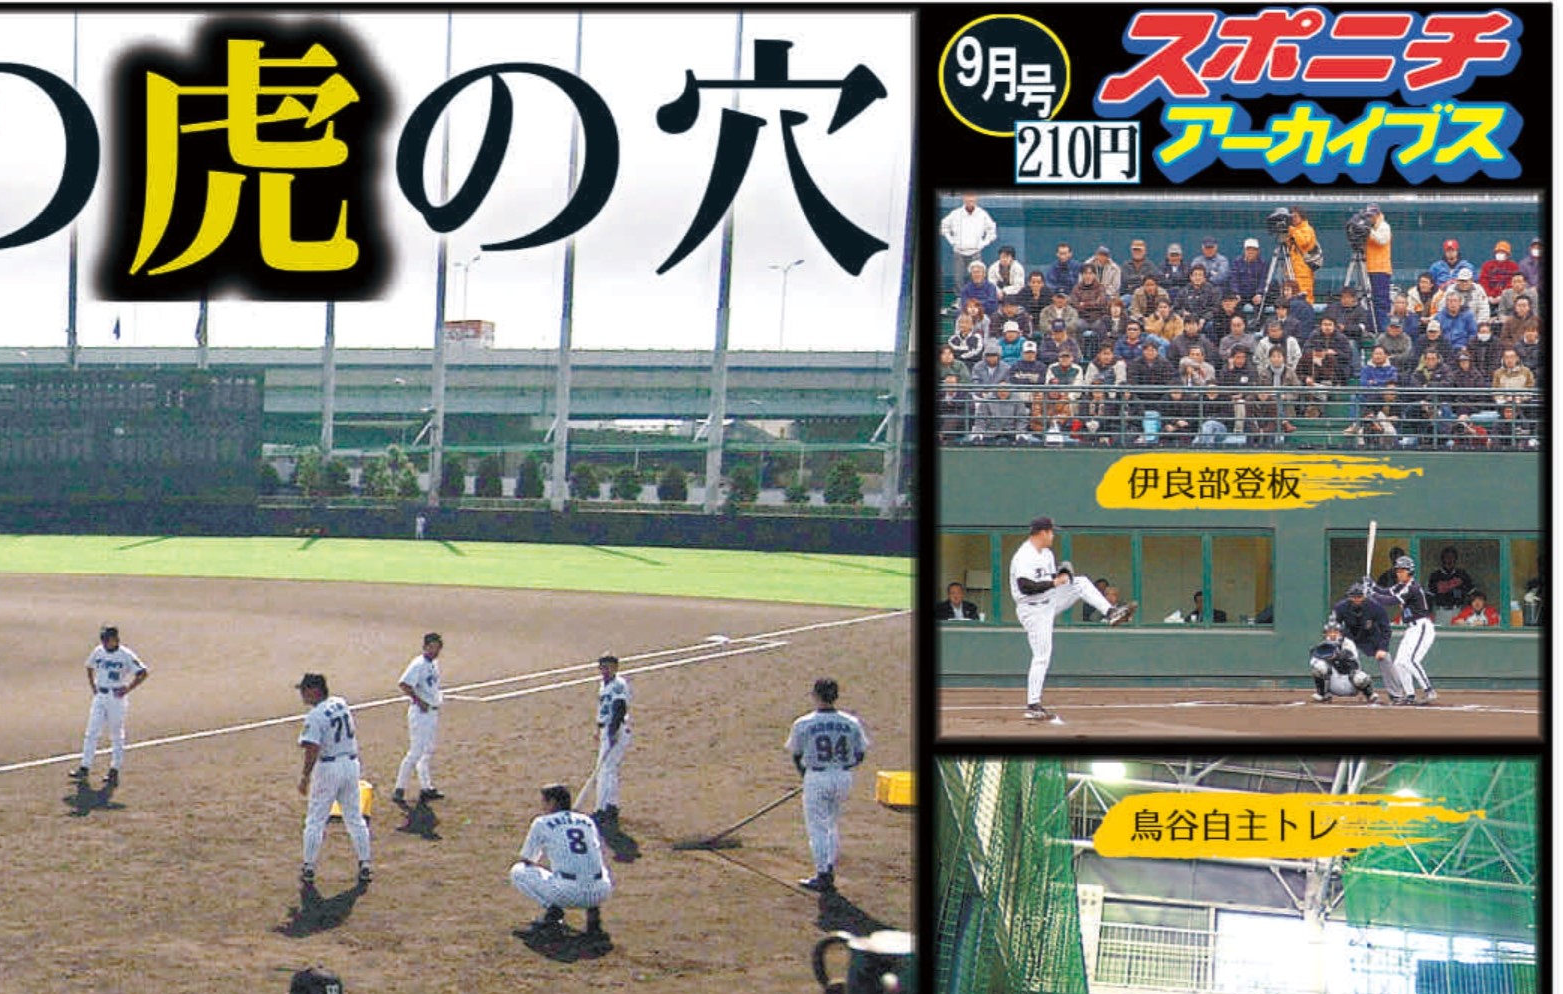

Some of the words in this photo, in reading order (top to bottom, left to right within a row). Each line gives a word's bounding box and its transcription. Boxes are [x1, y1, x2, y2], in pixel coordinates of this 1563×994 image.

[1018, 125, 1138, 180] 210円
[815, 734, 850, 762] 94
[566, 828, 588, 855] 8
